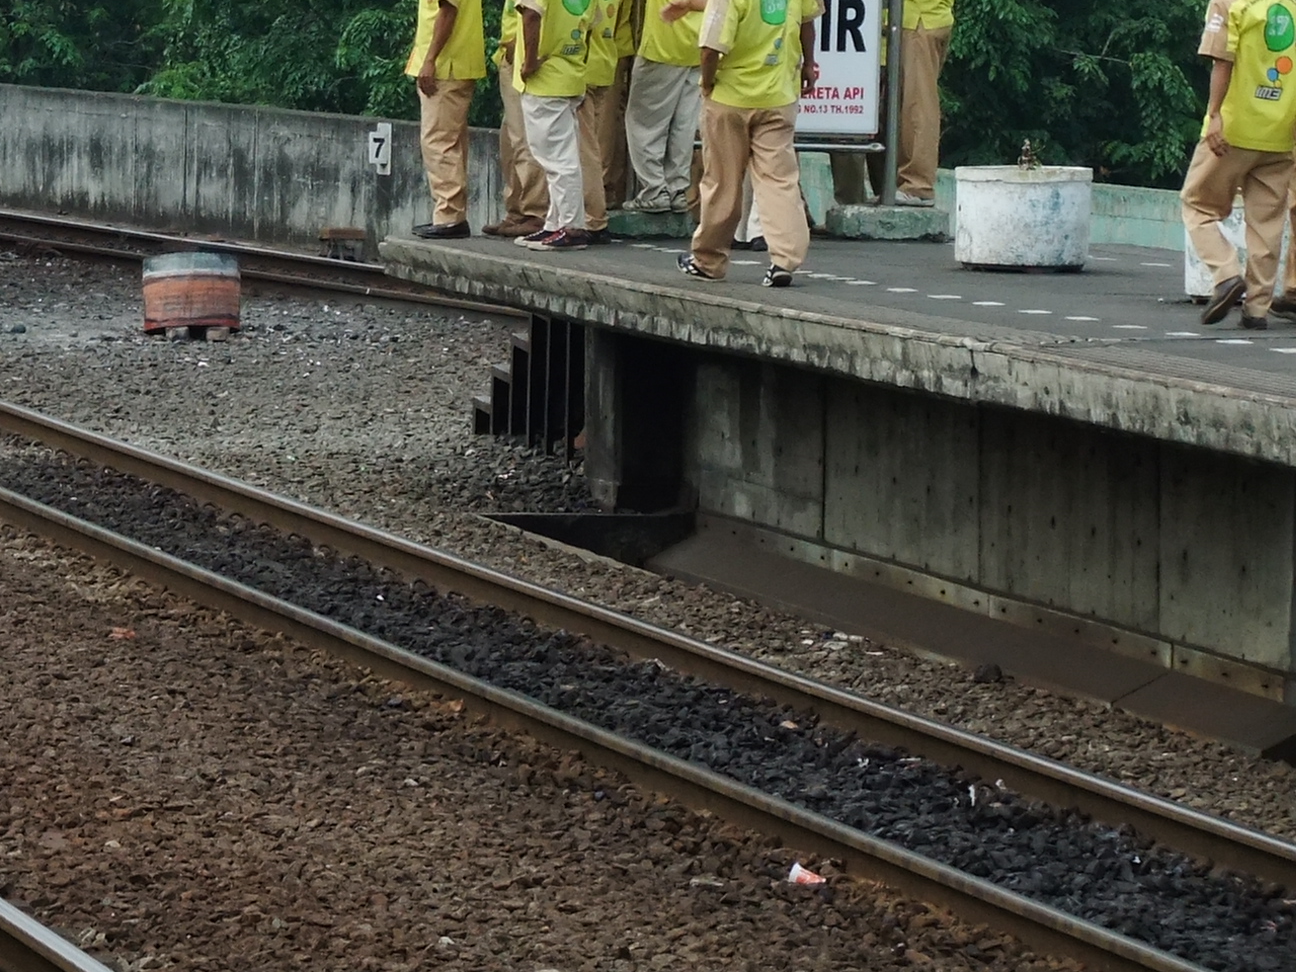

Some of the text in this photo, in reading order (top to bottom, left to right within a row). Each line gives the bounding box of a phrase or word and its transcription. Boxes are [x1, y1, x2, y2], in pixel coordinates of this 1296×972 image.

[843, 87, 864, 100] API
[804, 104, 828, 114] NO.13
[373, 137, 385, 159] 7
